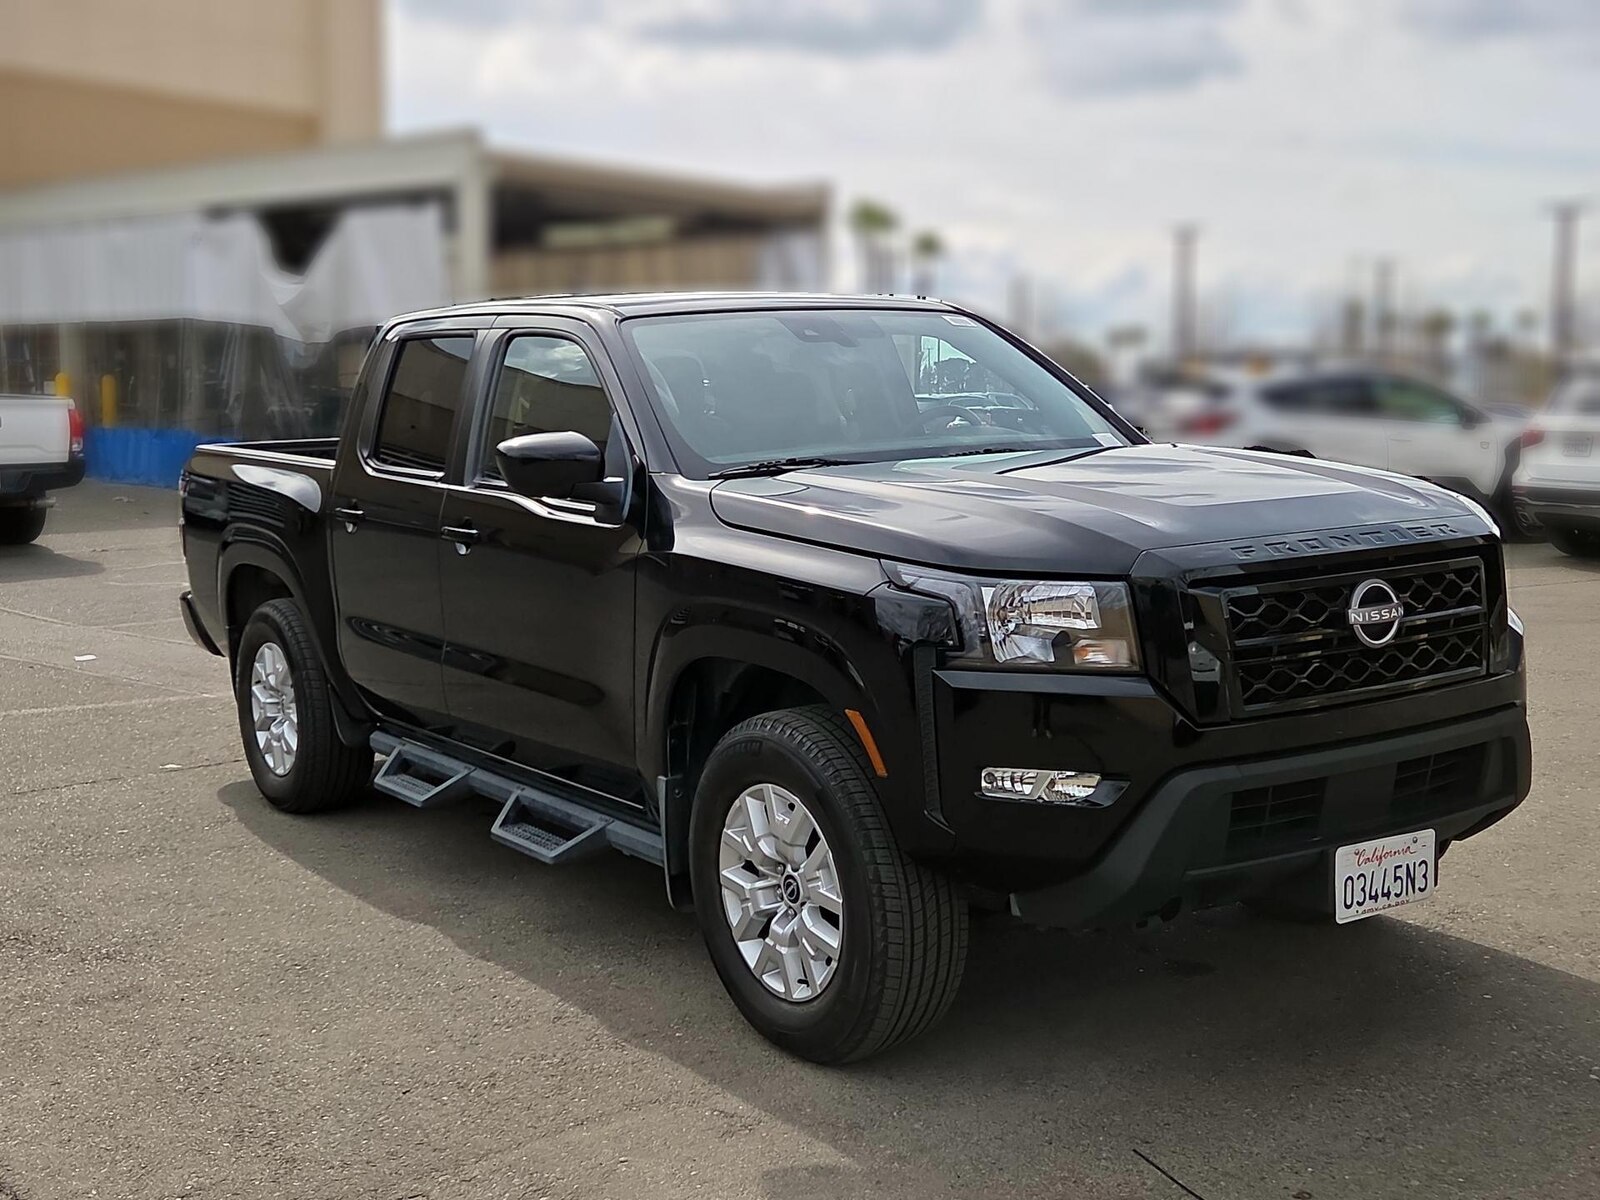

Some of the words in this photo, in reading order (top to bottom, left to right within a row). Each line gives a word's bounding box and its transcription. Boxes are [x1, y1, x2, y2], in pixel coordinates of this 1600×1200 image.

[1230, 523, 1459, 559] FRONTIER
[1351, 607, 1403, 622] NISSAN
[1357, 845, 1416, 867] California
[1344, 860, 1429, 909] 03445N3
